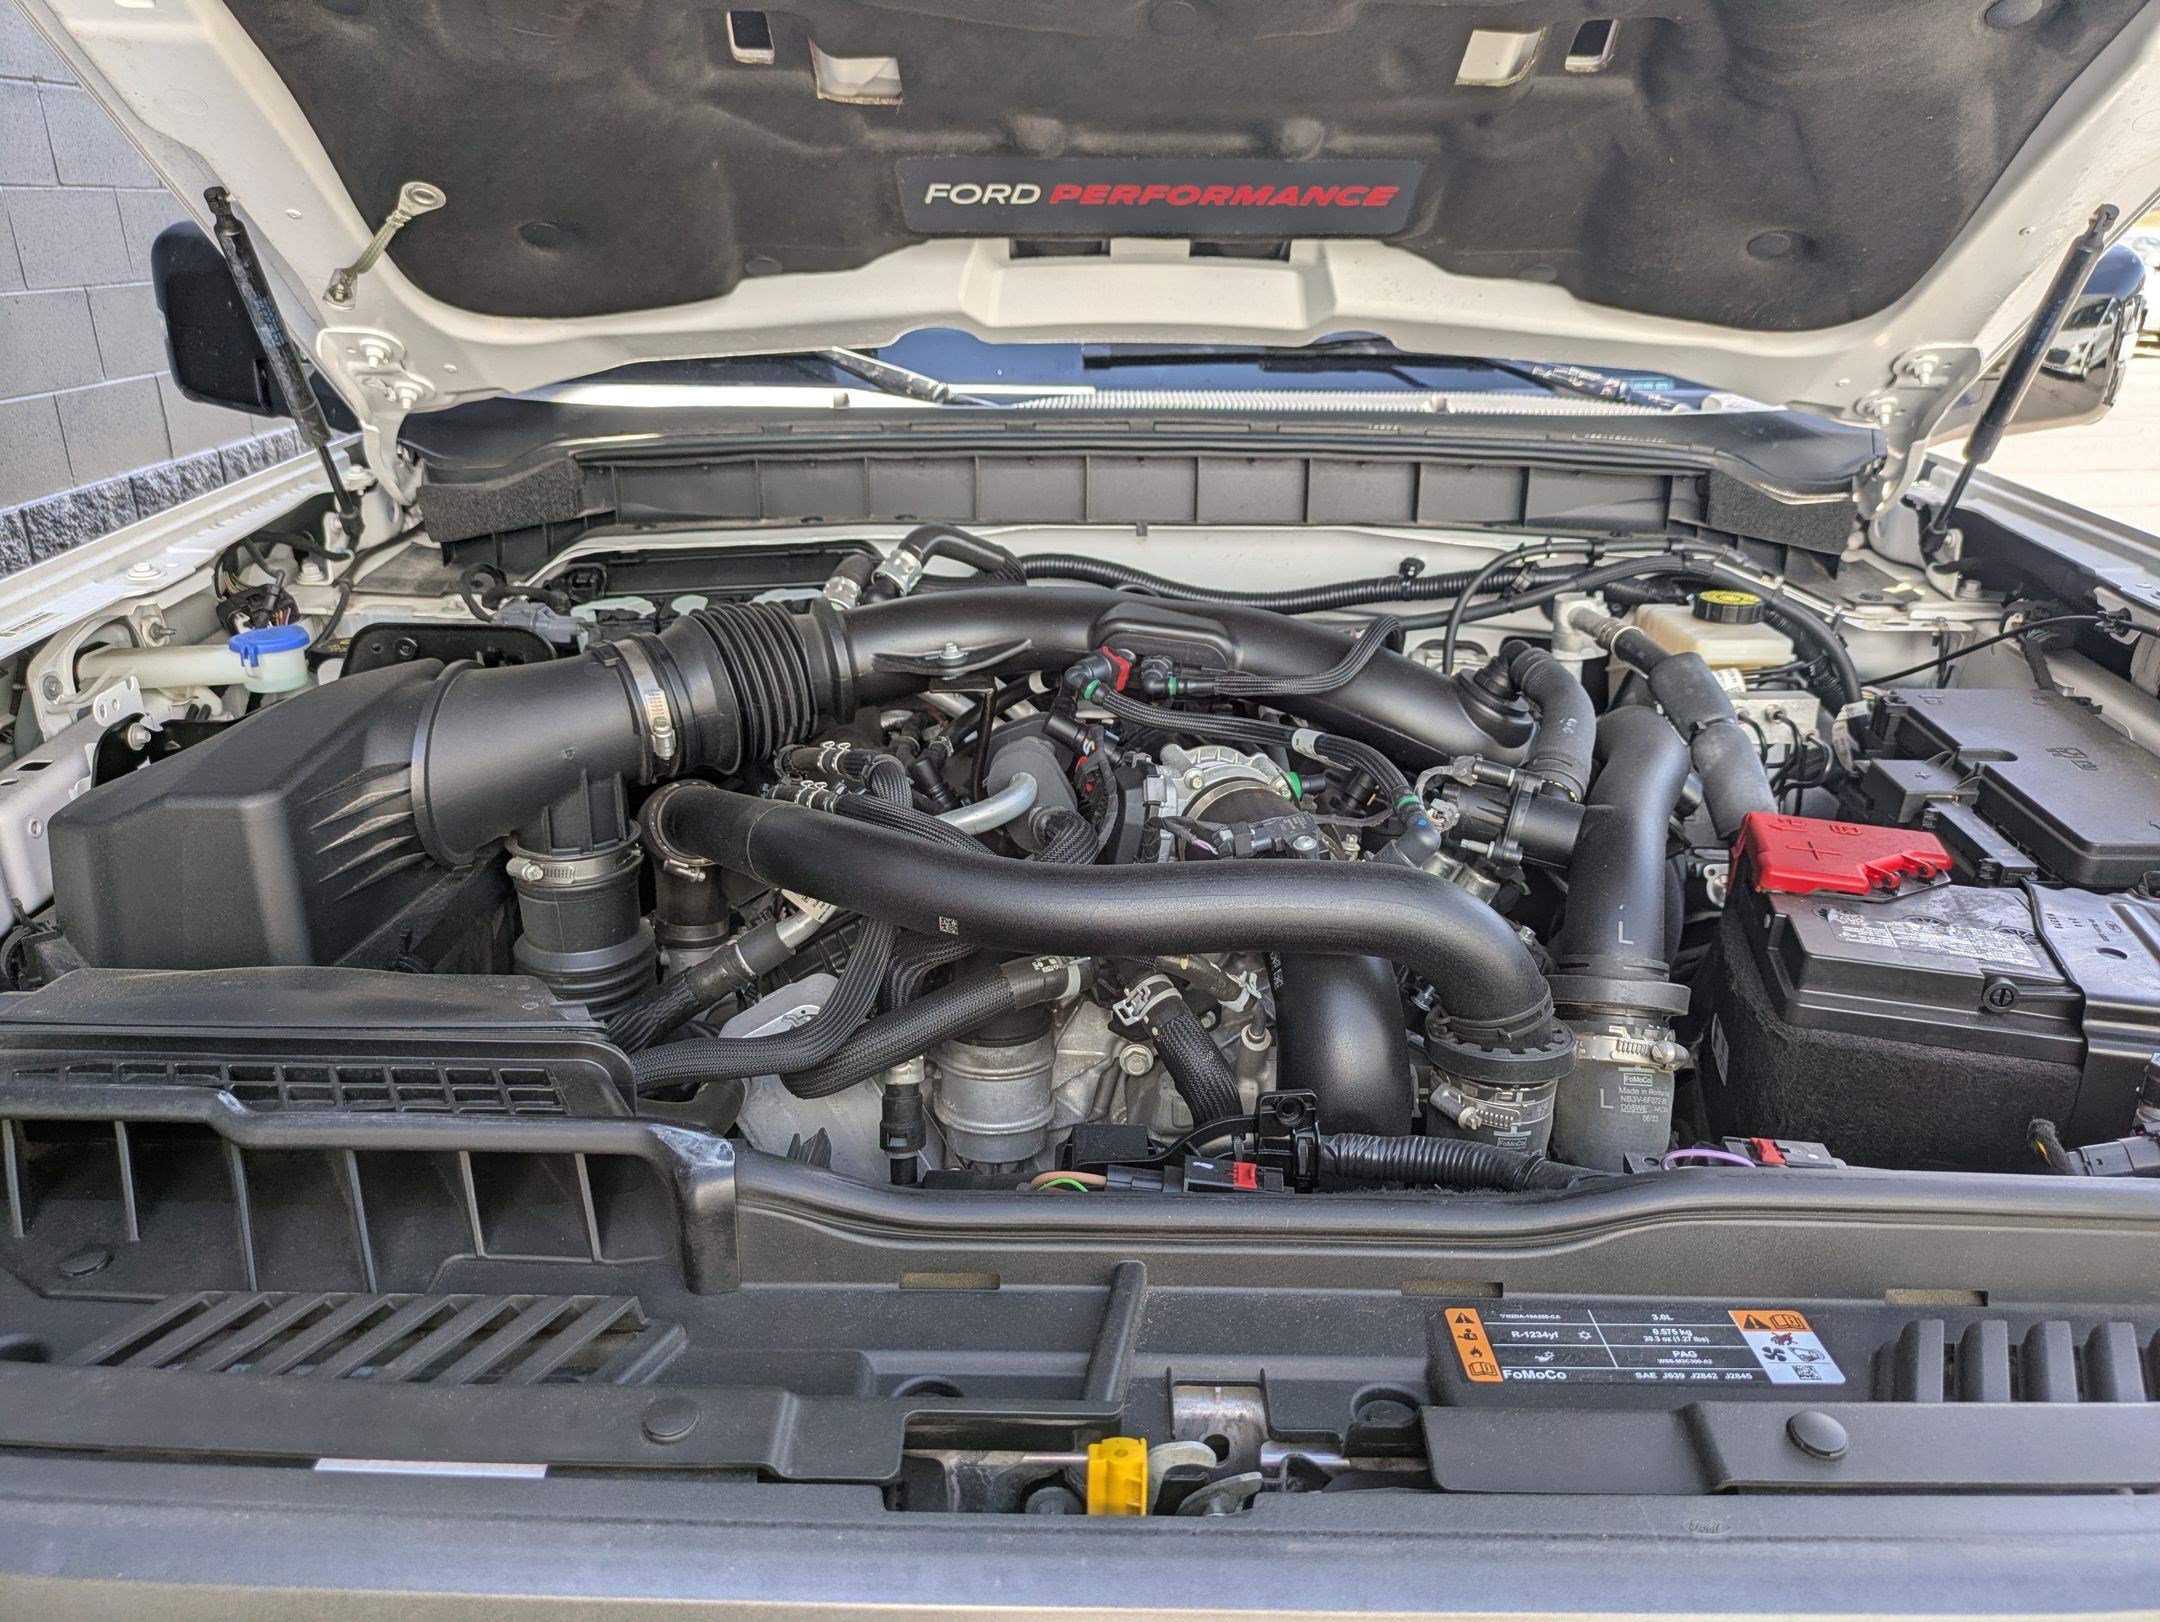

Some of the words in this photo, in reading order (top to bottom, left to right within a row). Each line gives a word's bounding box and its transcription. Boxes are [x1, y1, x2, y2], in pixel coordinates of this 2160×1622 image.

[924, 183, 1042, 205] FORD
[1048, 184, 1400, 207] PERFORMANCE
[1618, 920, 1634, 945] L
[1624, 1075, 1652, 1084] FoMoCo
[1618, 1086, 1640, 1095] Made
[1641, 1087, 1647, 1095] in
[1600, 1088, 1615, 1109] L
[1511, 1330, 1559, 1340] R-1234yf
[1652, 1328, 1678, 1336] 0.575
[1679, 1328, 1693, 1337] kg
[1672, 1350, 1698, 1358] PAG
[1502, 1369, 1568, 1380] FoMoCo
[1662, 1372, 1686, 1380] J639
